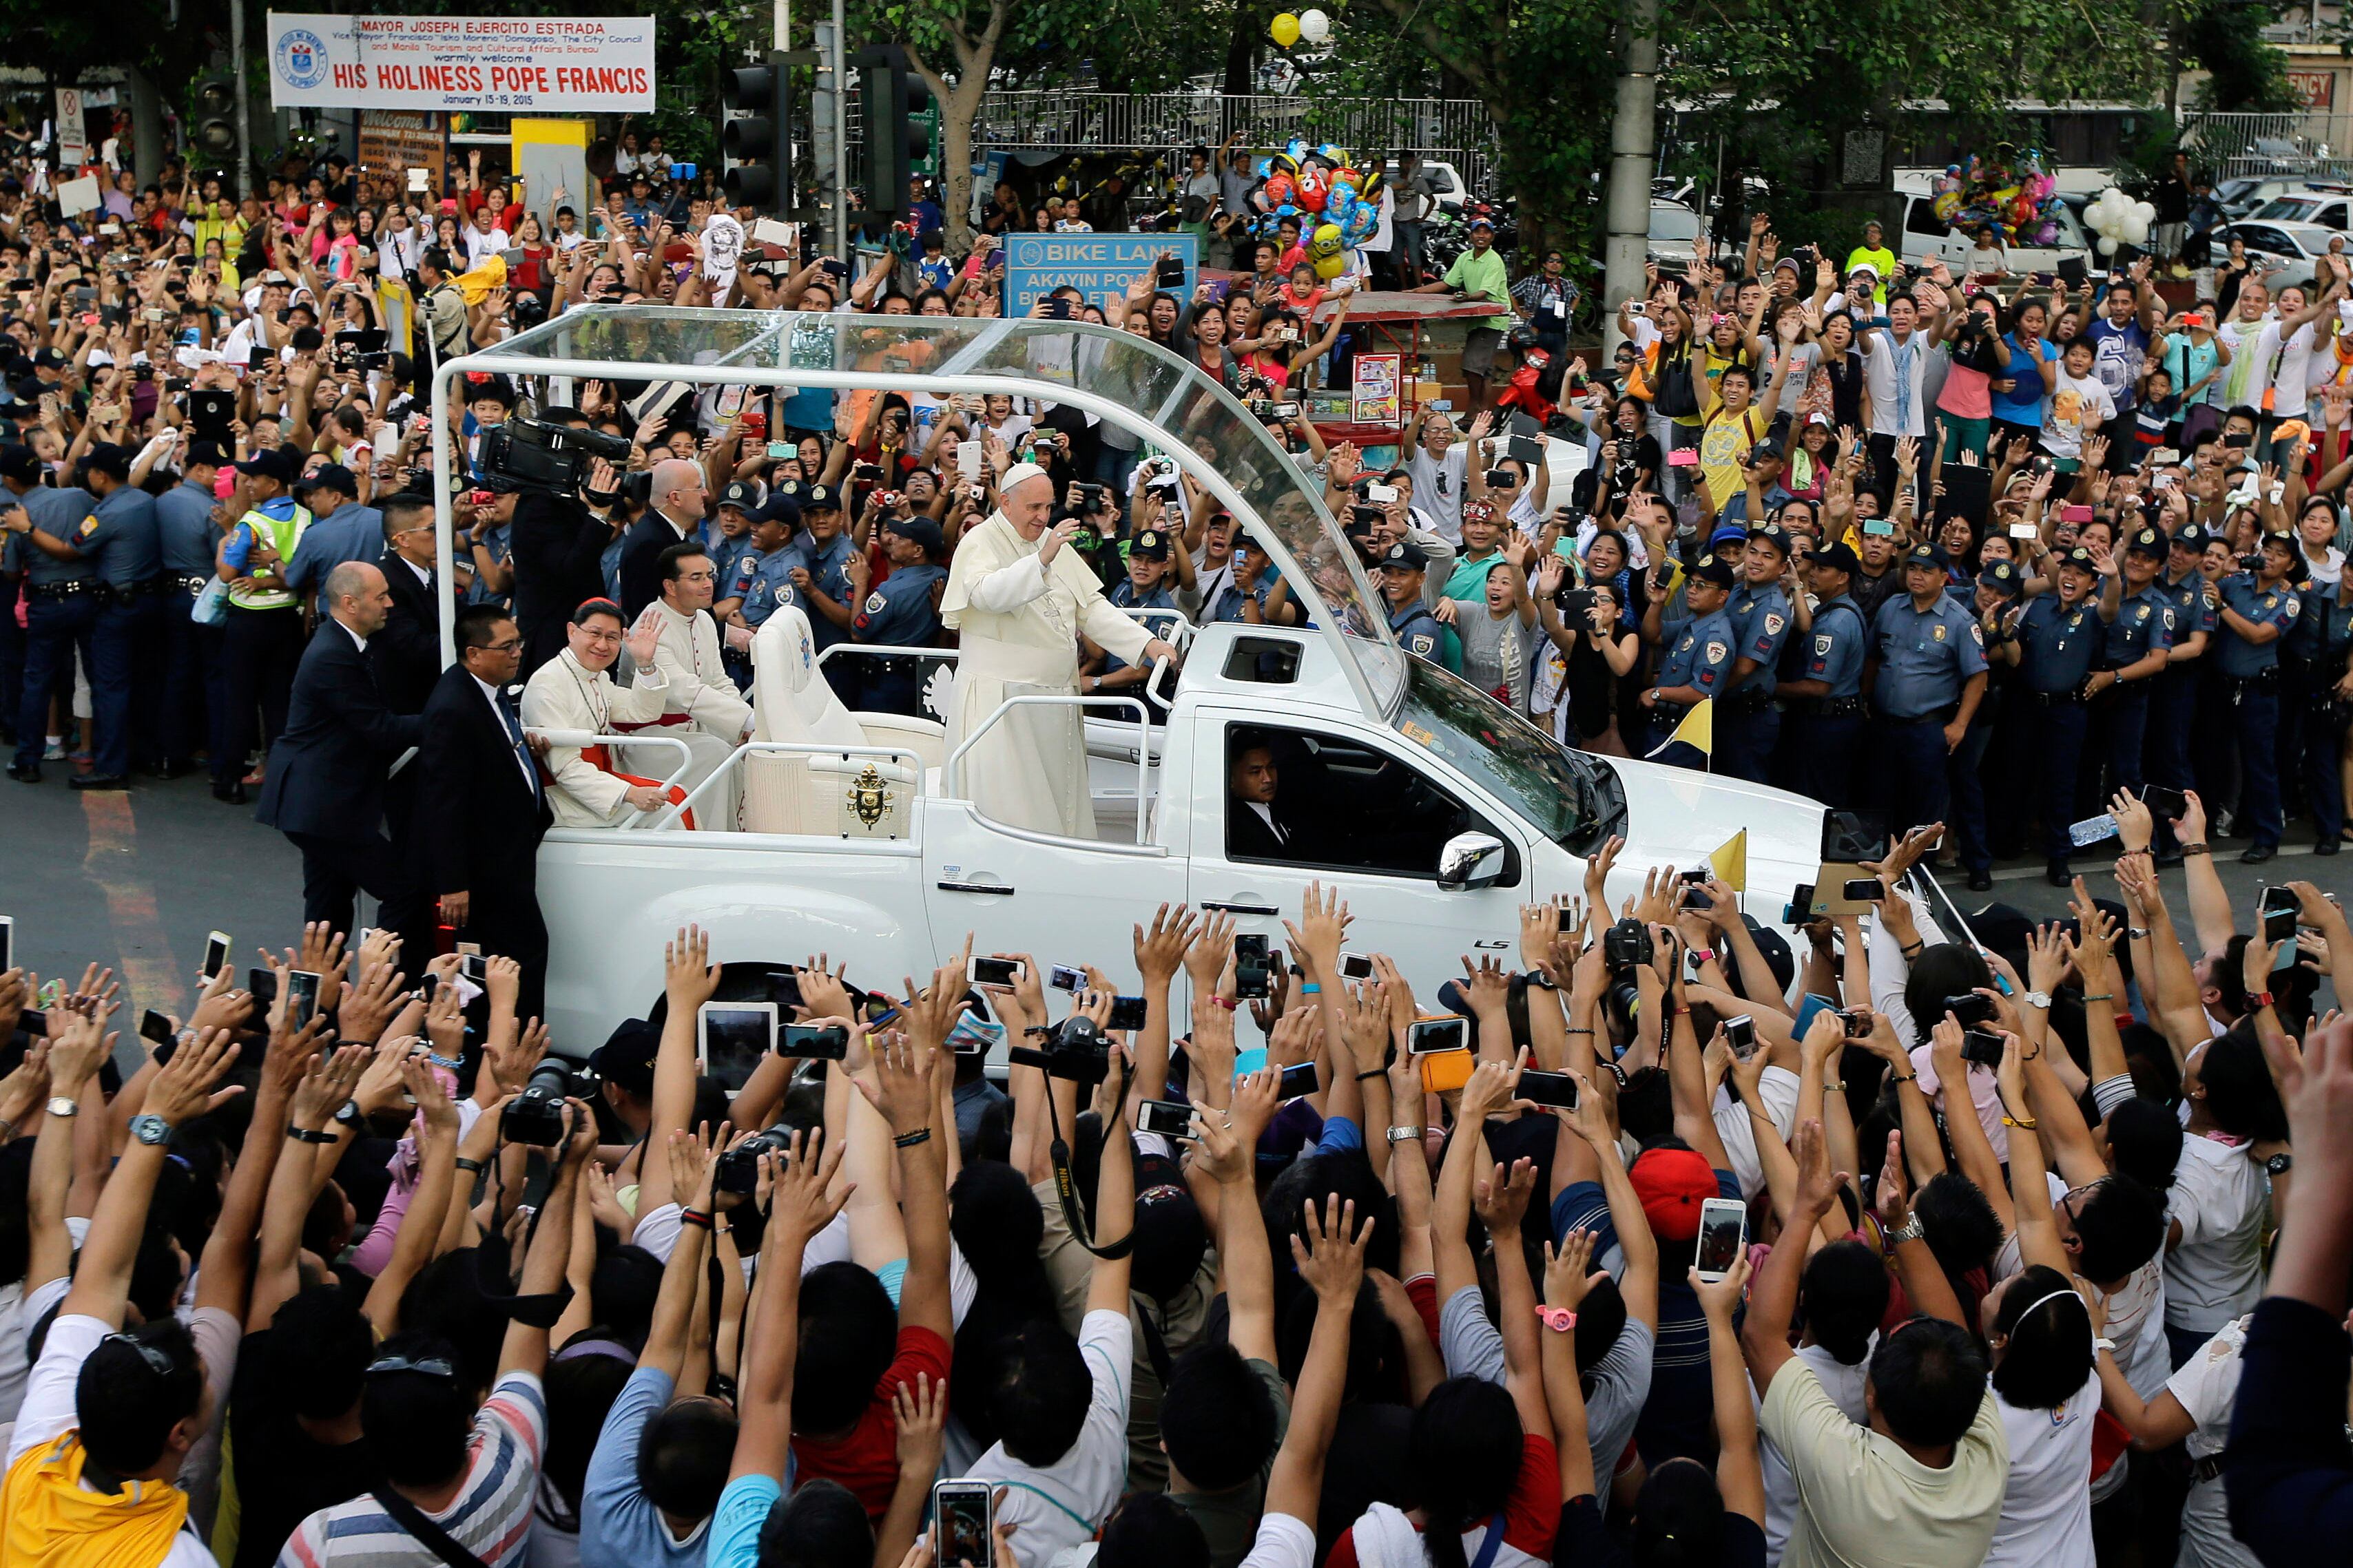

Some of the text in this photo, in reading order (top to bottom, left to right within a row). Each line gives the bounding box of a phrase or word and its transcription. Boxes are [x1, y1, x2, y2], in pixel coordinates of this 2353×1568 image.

[361, 21, 605, 34] MAYOR JOSEPH EJERCITO ESTRADA
[356, 33, 384, 41] Mayor
[584, 35, 604, 44] City
[393, 43, 419, 51] Manila
[426, 43, 462, 52] Tourism
[487, 44, 525, 52] Cultural
[528, 45, 562, 53] Affairs
[567, 45, 599, 53] Bureau
[434, 53, 532, 63] warmly welcome
[333, 63, 648, 94] HIS HOLINESS POPE FRANCIS
[442, 94, 532, 106] January 15-19, 2015
[1047, 244, 1183, 261] BIKE LANE
[1026, 273, 1097, 287] AKAYIN
[1473, 939, 1511, 949] LS
[1058, 1168, 1070, 1197] Nikon
